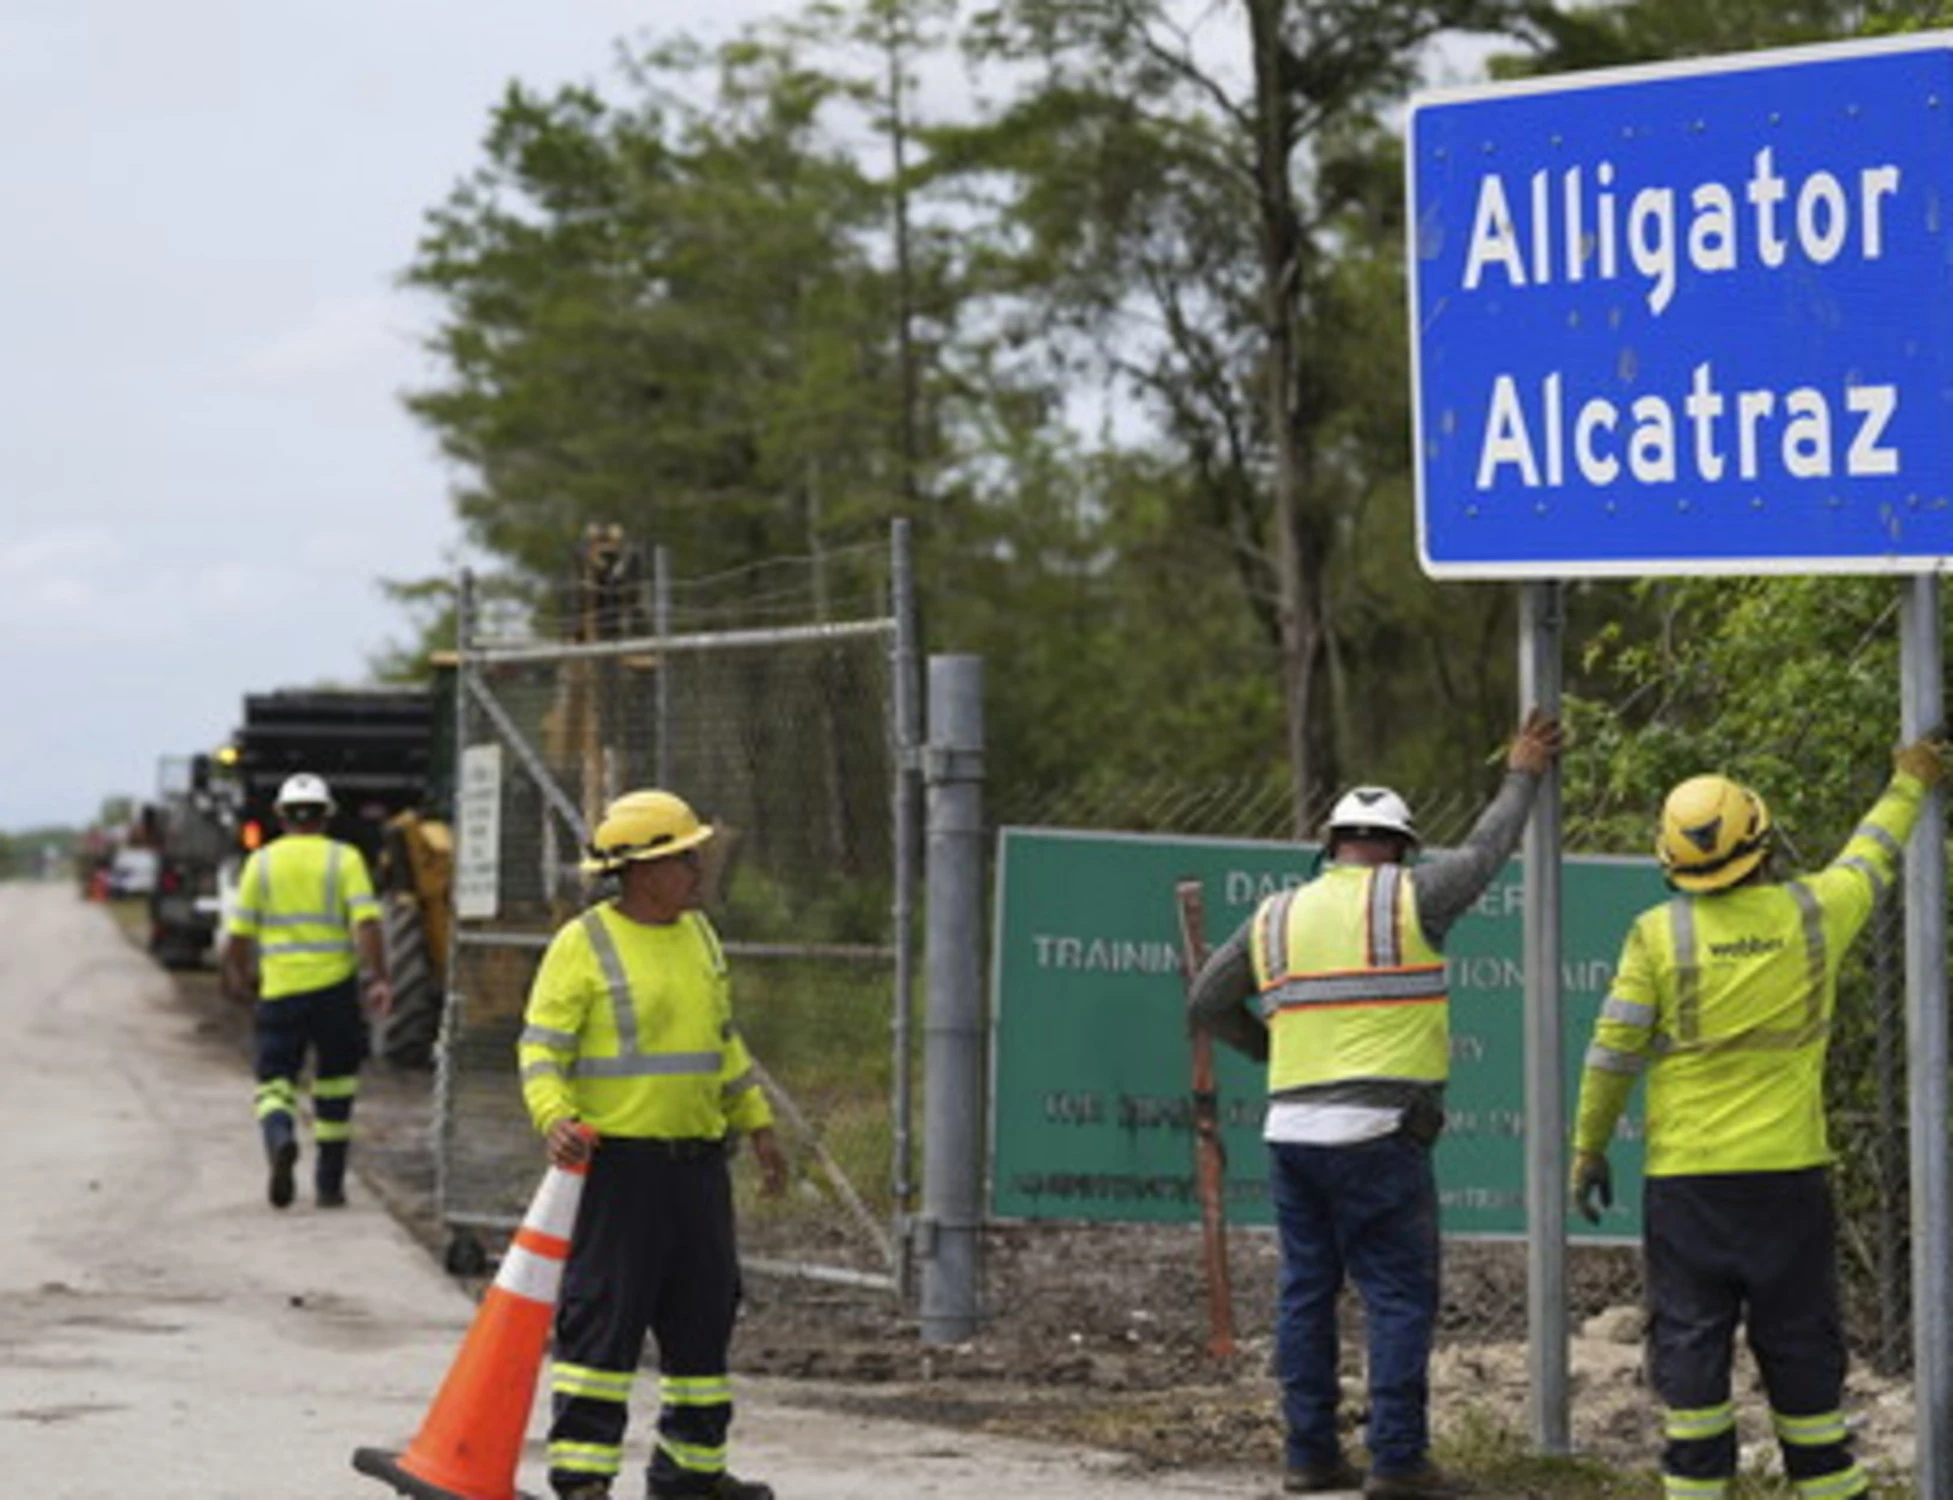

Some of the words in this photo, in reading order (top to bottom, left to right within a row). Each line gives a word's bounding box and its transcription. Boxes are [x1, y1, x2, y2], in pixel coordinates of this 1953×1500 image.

[1463, 147, 1900, 317] Alligator
[1476, 361, 1900, 490] Alcatraz
[1033, 934, 1183, 974] TRAININ
